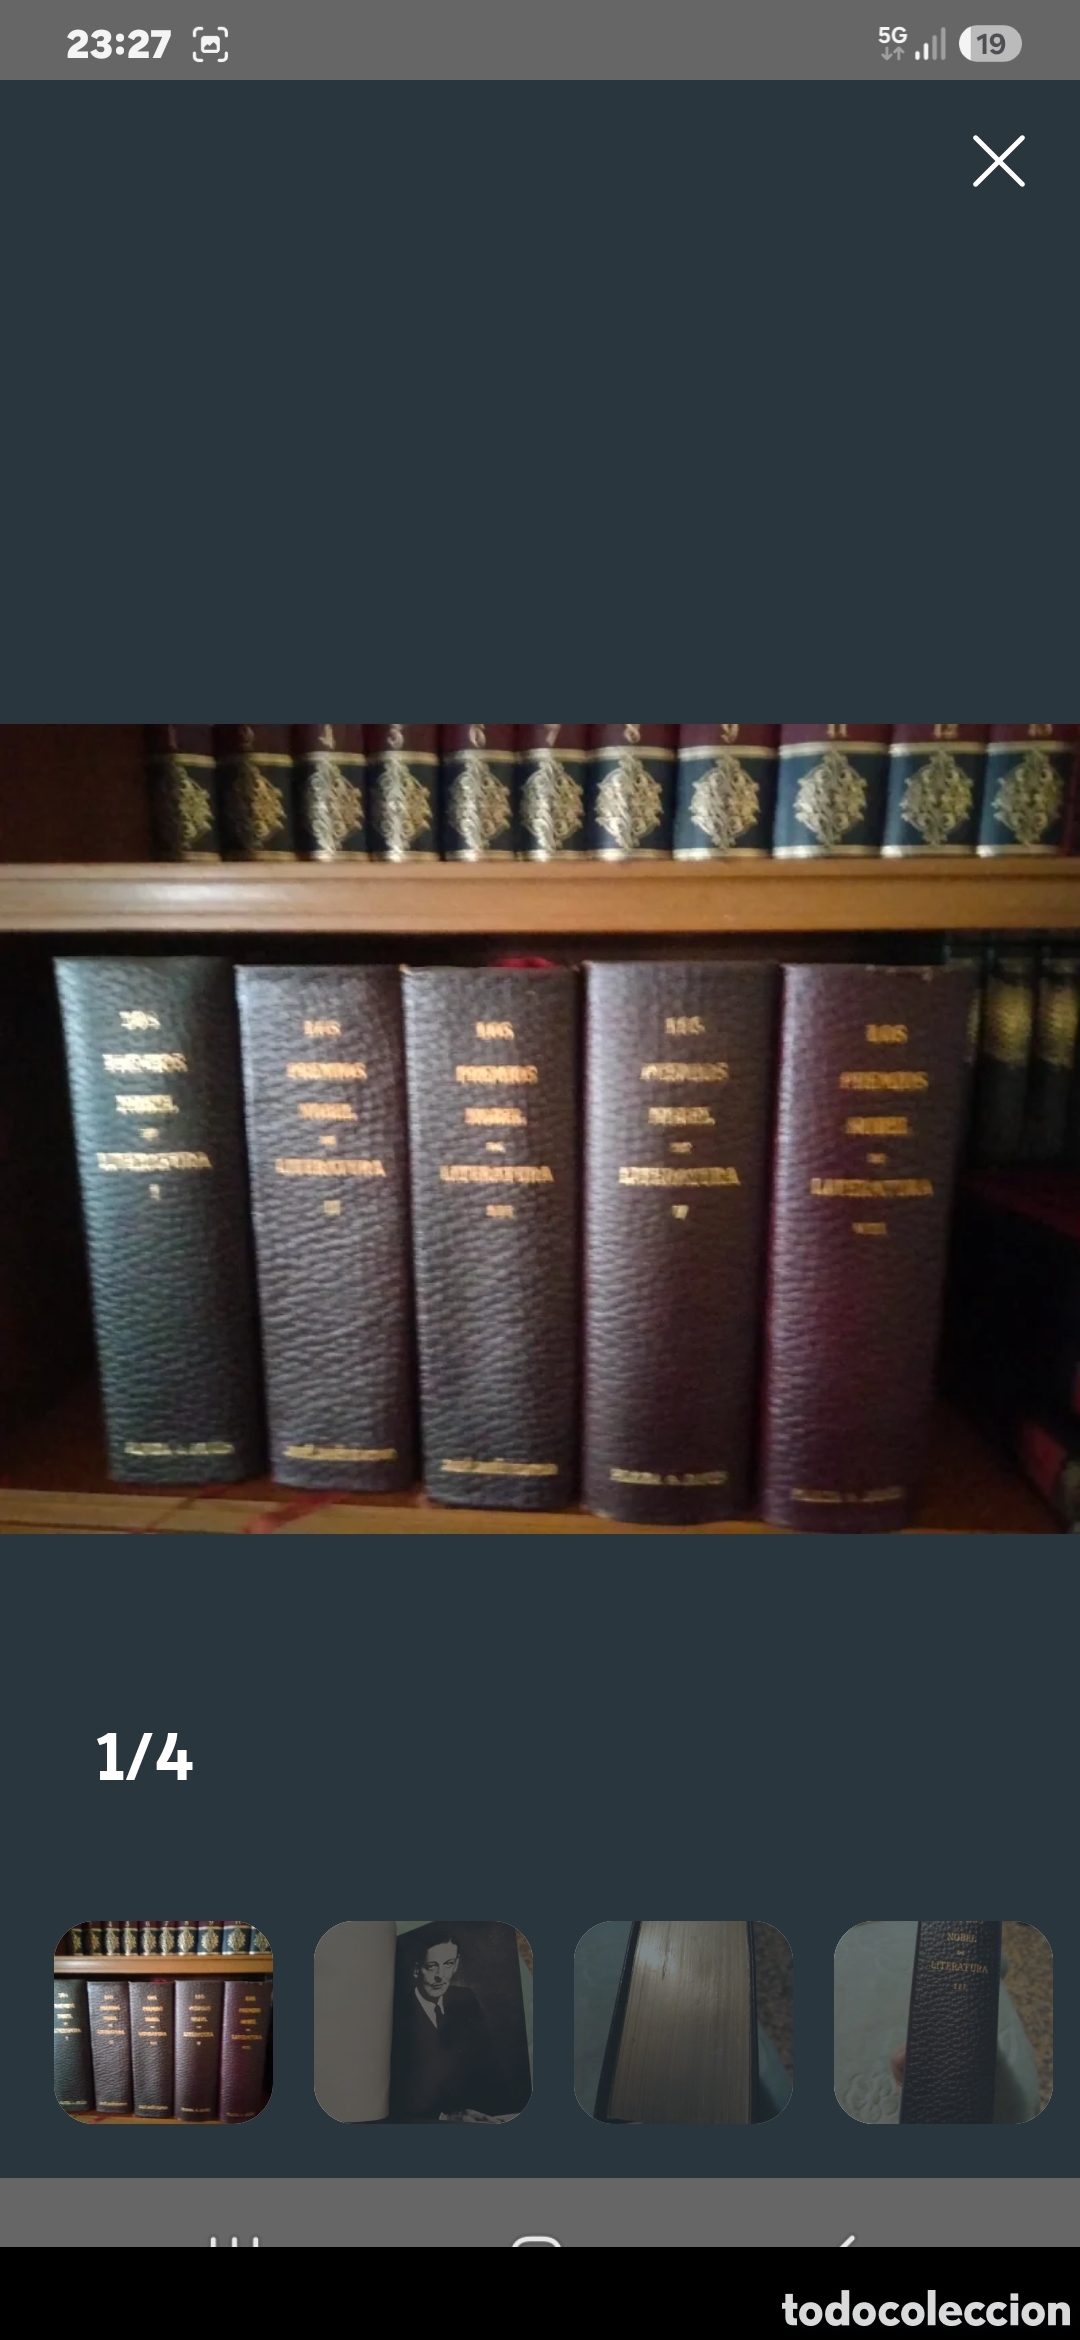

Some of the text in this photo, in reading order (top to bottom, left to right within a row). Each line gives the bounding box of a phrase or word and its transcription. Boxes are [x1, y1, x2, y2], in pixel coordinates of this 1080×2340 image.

[66, 28, 172, 60] 23:27
[878, 26, 908, 44] 5G
[976, 33, 1006, 55] 19
[96, 1732, 194, 1781] 1/4
[947, 1932, 977, 1943] NOBEL
[930, 1960, 988, 1974] LITERATURA
